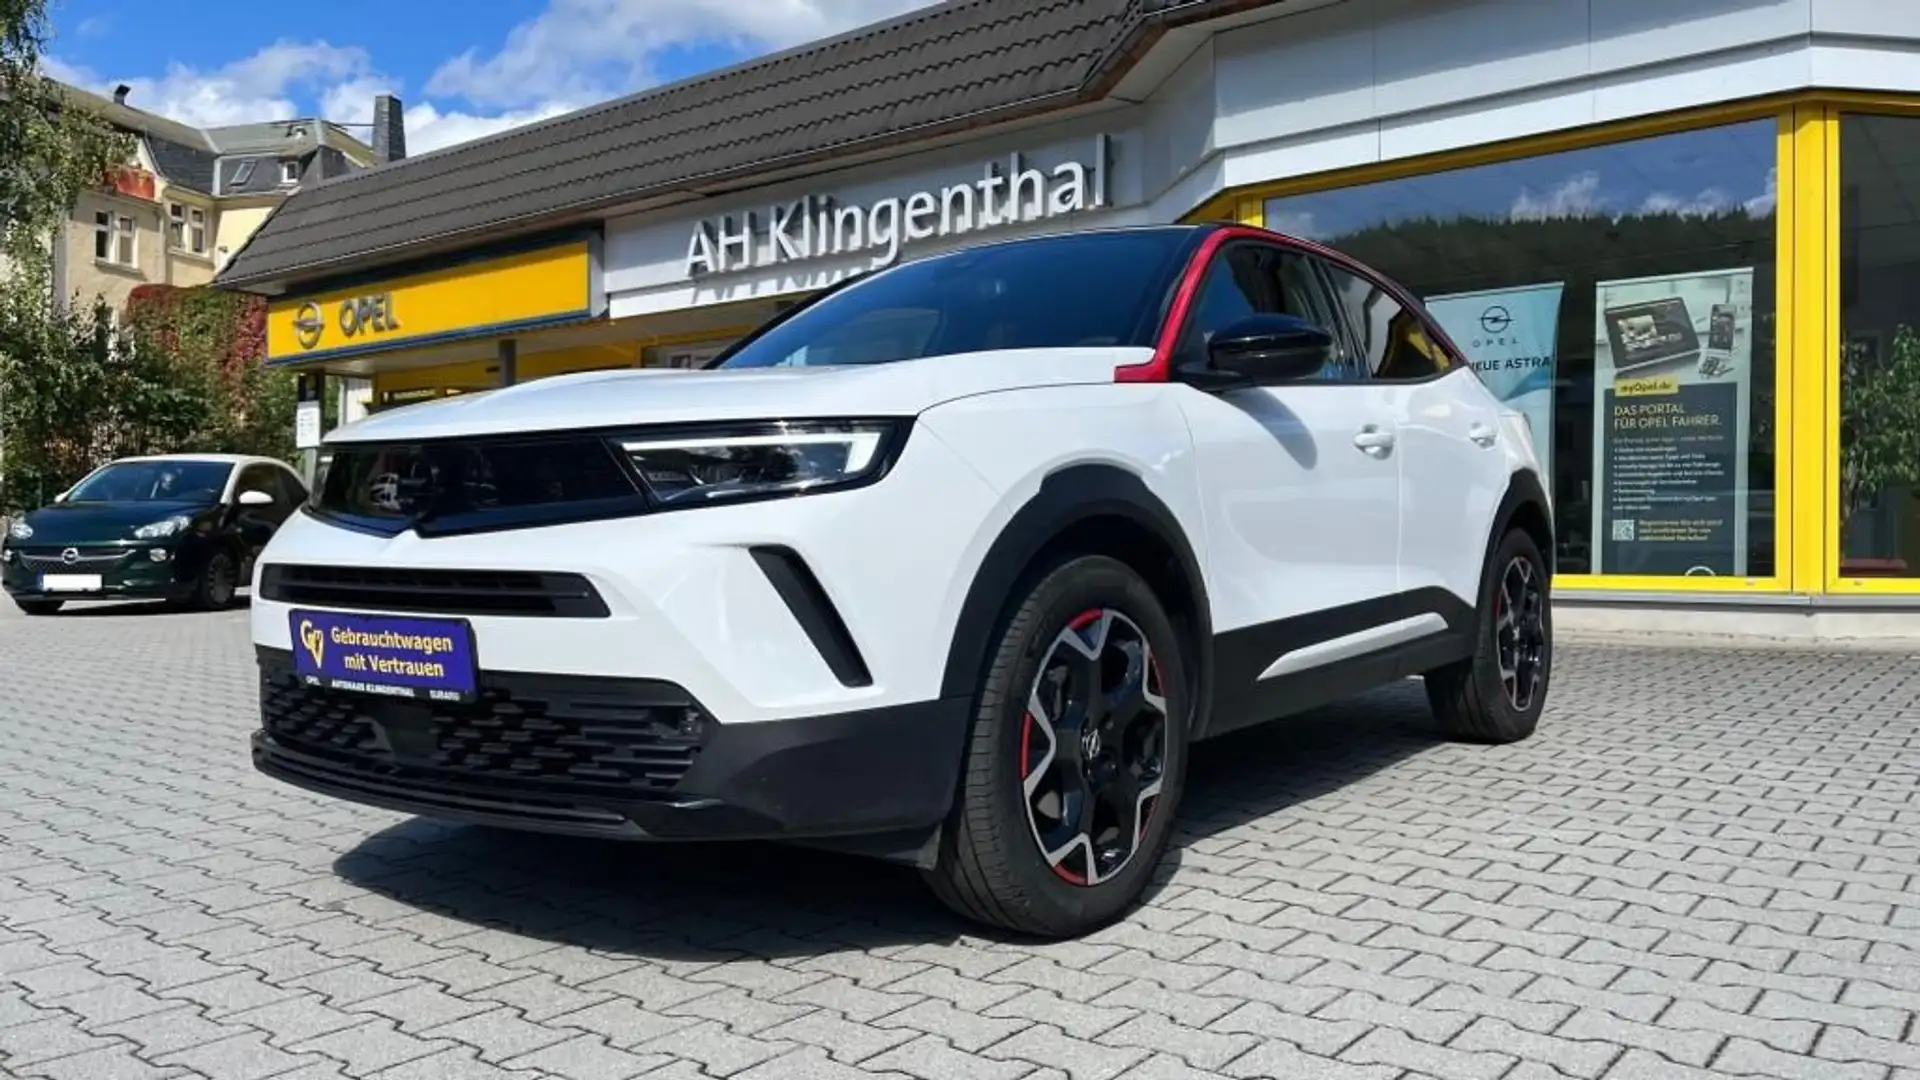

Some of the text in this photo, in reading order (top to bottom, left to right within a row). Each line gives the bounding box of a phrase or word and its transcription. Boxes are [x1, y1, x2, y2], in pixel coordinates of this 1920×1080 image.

[685, 133, 1111, 276] AH Klingenthal
[339, 293, 400, 338] OPEL
[1472, 337, 1519, 348] OPEL
[1505, 356, 1550, 370] ASTRA
[1614, 402, 1685, 416] DAS PORTAL
[1614, 413, 1723, 430] FÜR OPEL FAHRER.
[331, 626, 453, 654] Gebrauchtwagen
[344, 653, 445, 678] mit Vertrauen
